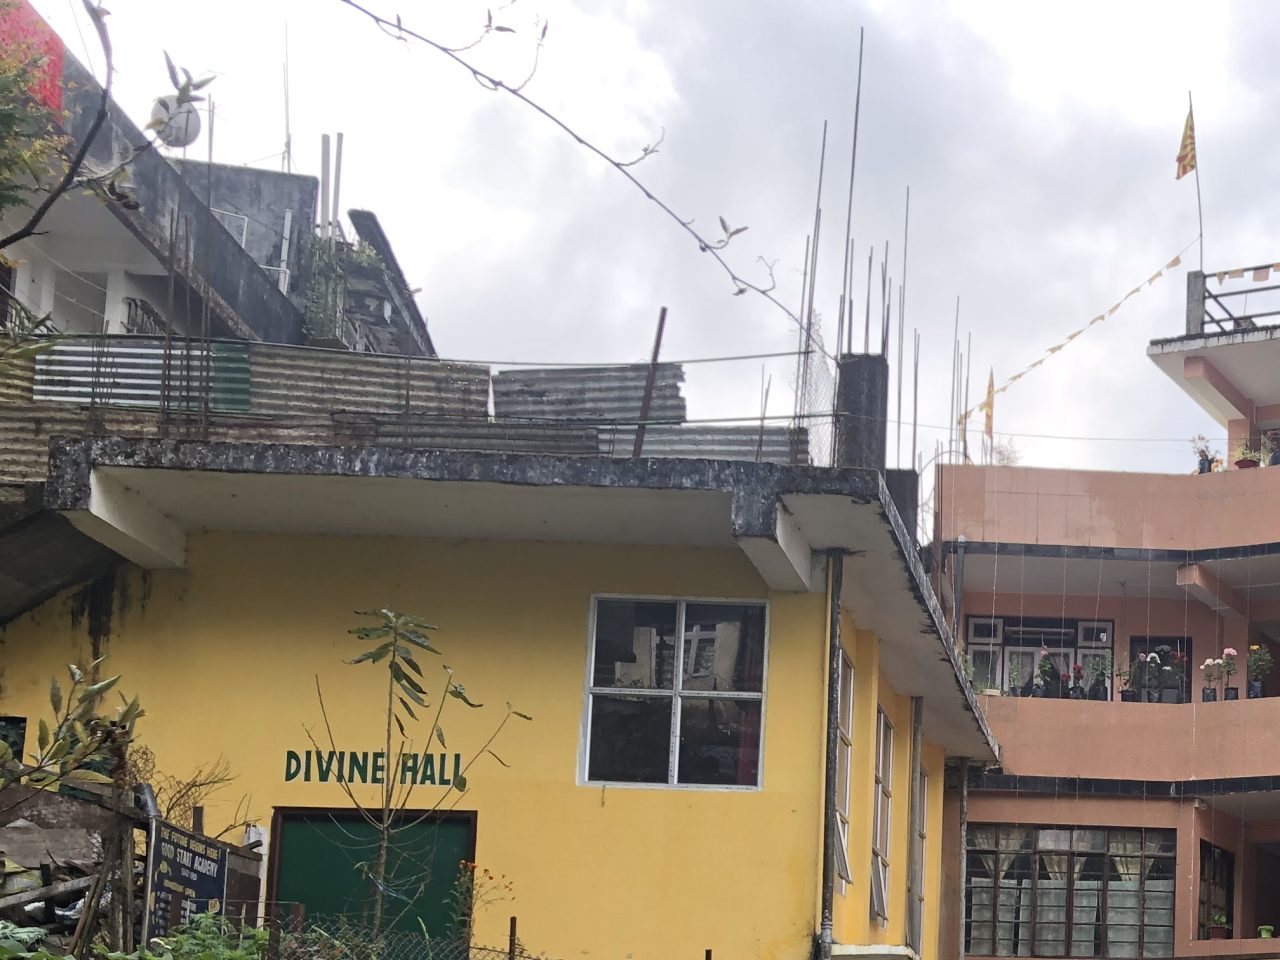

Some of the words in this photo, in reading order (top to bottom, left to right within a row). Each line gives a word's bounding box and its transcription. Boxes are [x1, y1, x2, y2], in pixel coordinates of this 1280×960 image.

[285, 750, 385, 784] DIVINE
[400, 753, 464, 785] HALL
[177, 847, 192, 867] START
[194, 855, 218, 877] ACADEMY
